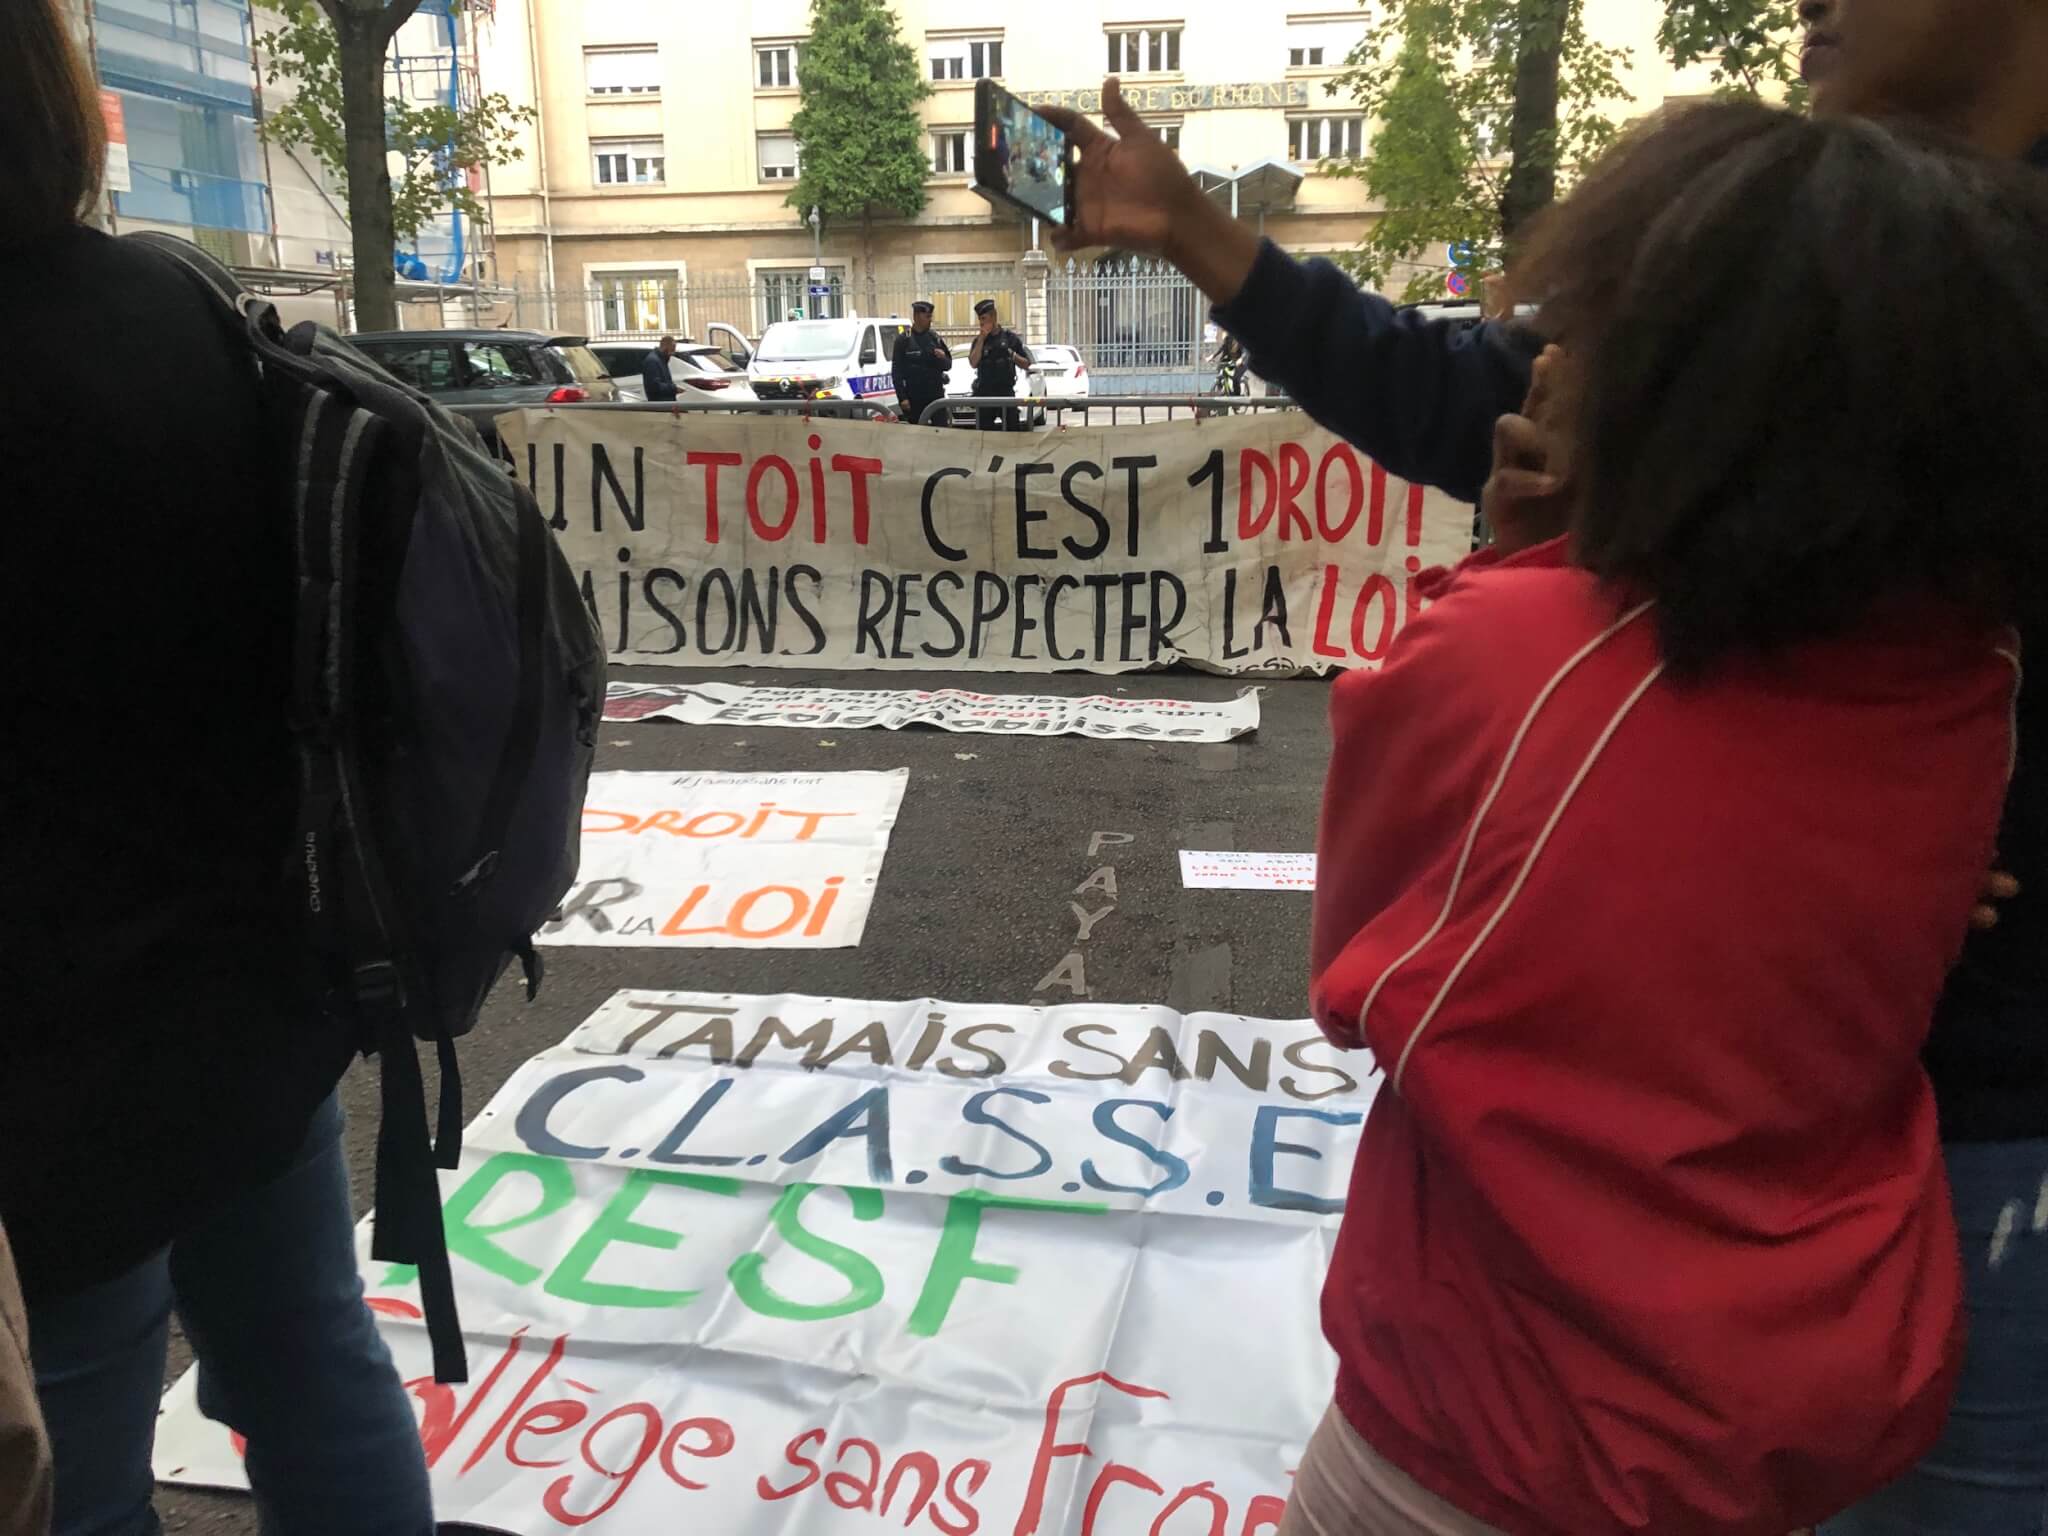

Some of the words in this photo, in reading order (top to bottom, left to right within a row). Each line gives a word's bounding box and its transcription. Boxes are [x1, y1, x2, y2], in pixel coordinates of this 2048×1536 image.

[528, 443, 644, 532] UN
[921, 454, 1158, 561] C'EST
[855, 568, 1187, 661] RESPECTER
[1222, 565, 1293, 660] LA
[1030, 831, 1135, 1005] PAYA
[1047, 1022, 1357, 1101] SANS
[378, 1152, 1108, 1337] RESF
[757, 1427, 991, 1536] sans
